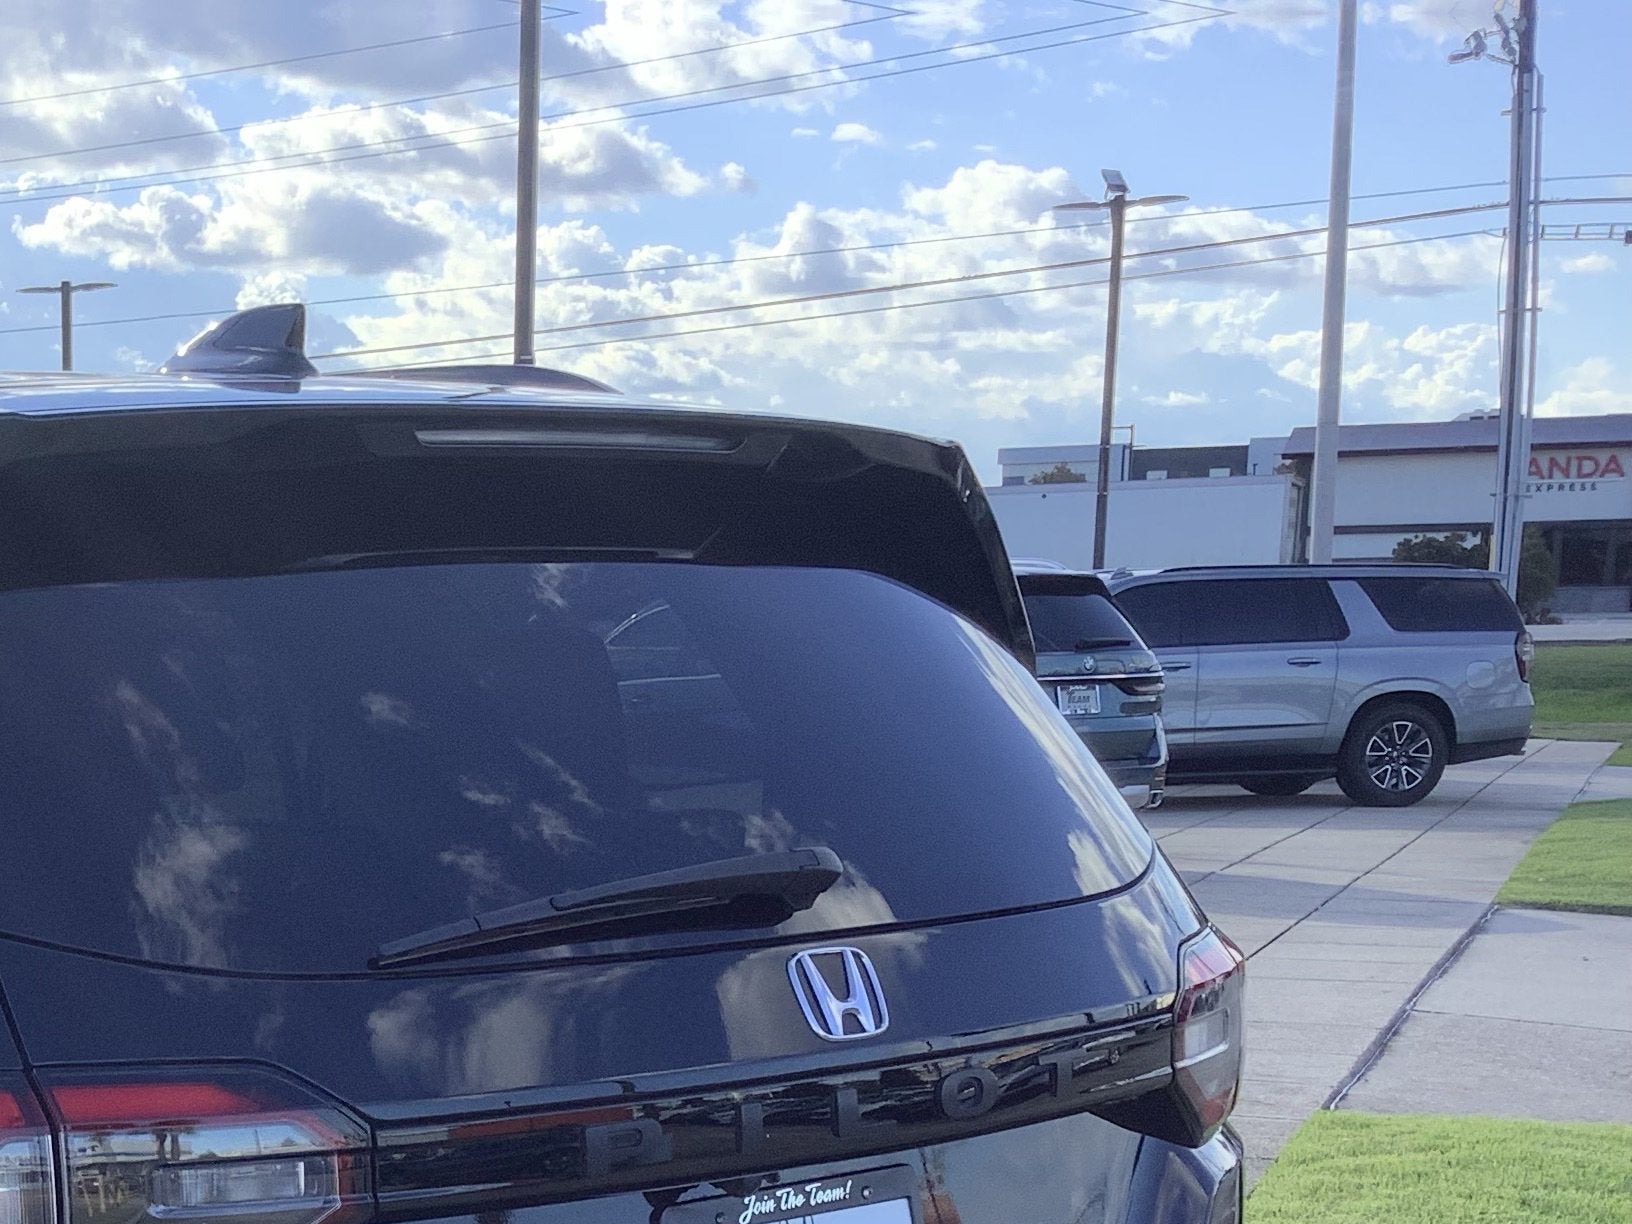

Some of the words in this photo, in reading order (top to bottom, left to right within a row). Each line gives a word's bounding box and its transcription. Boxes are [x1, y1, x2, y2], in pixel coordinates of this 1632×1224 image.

[1528, 453, 1625, 479] ANDA
[583, 1047, 1090, 1180] PILOT
[775, 1187, 806, 1211] The
[805, 1180, 853, 1207] Team!
